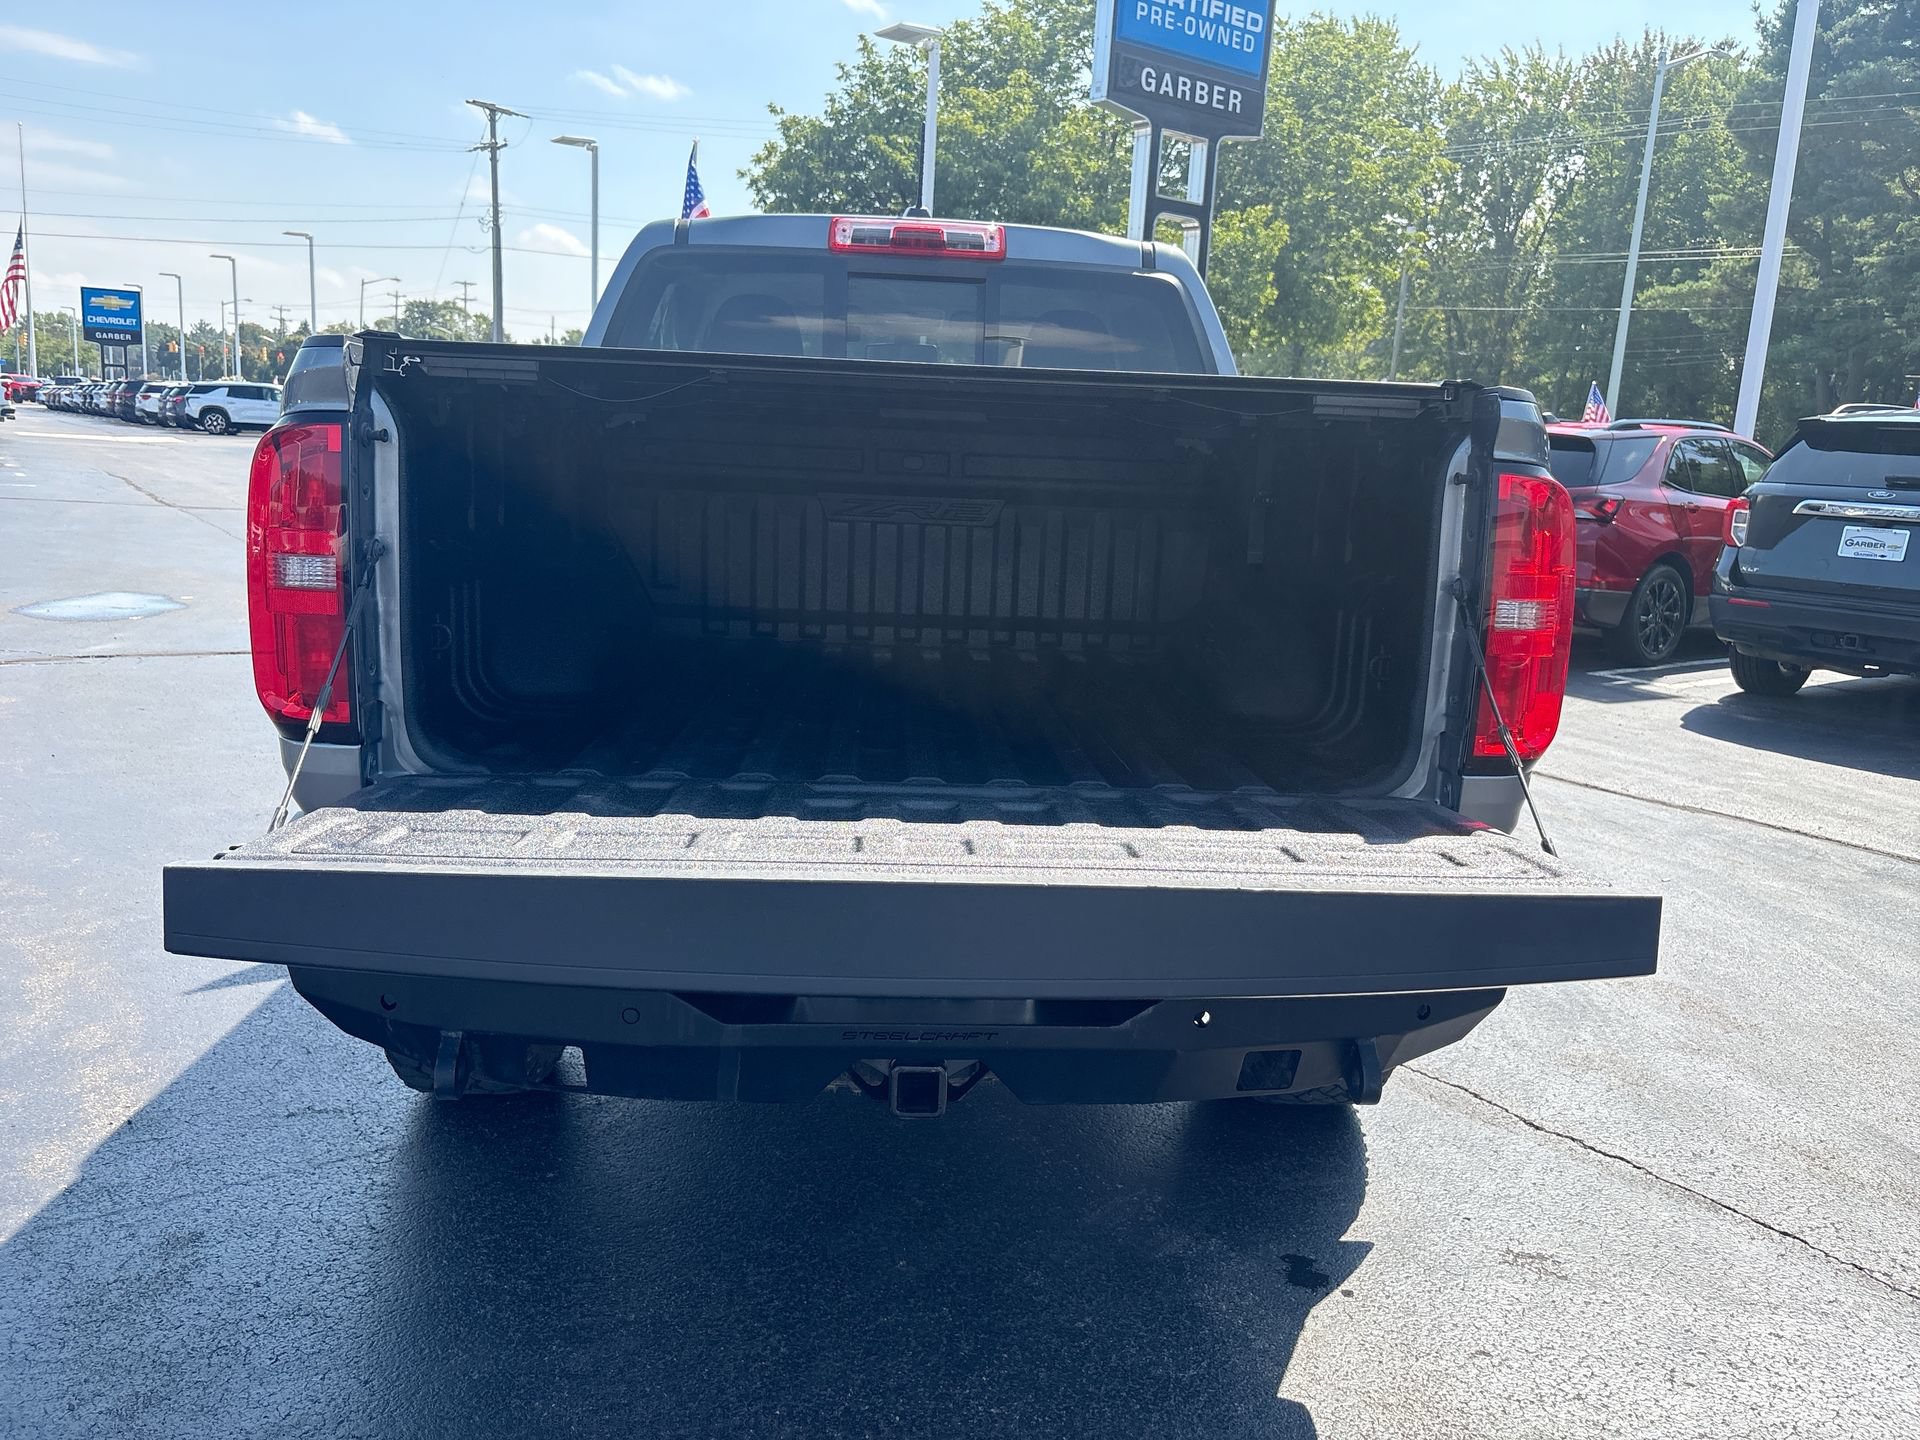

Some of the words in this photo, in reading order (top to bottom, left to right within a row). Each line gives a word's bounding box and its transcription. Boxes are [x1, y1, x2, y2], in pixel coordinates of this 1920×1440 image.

[1136, 1, 1256, 53] PRE-OWNED
[1141, 67, 1243, 114] GARBER
[87, 315, 137, 326] CHEVROLET
[95, 332, 132, 341] GARBER
[1845, 538, 1886, 549] GARBER
[841, 1031, 999, 1041] STEELCRAFT
